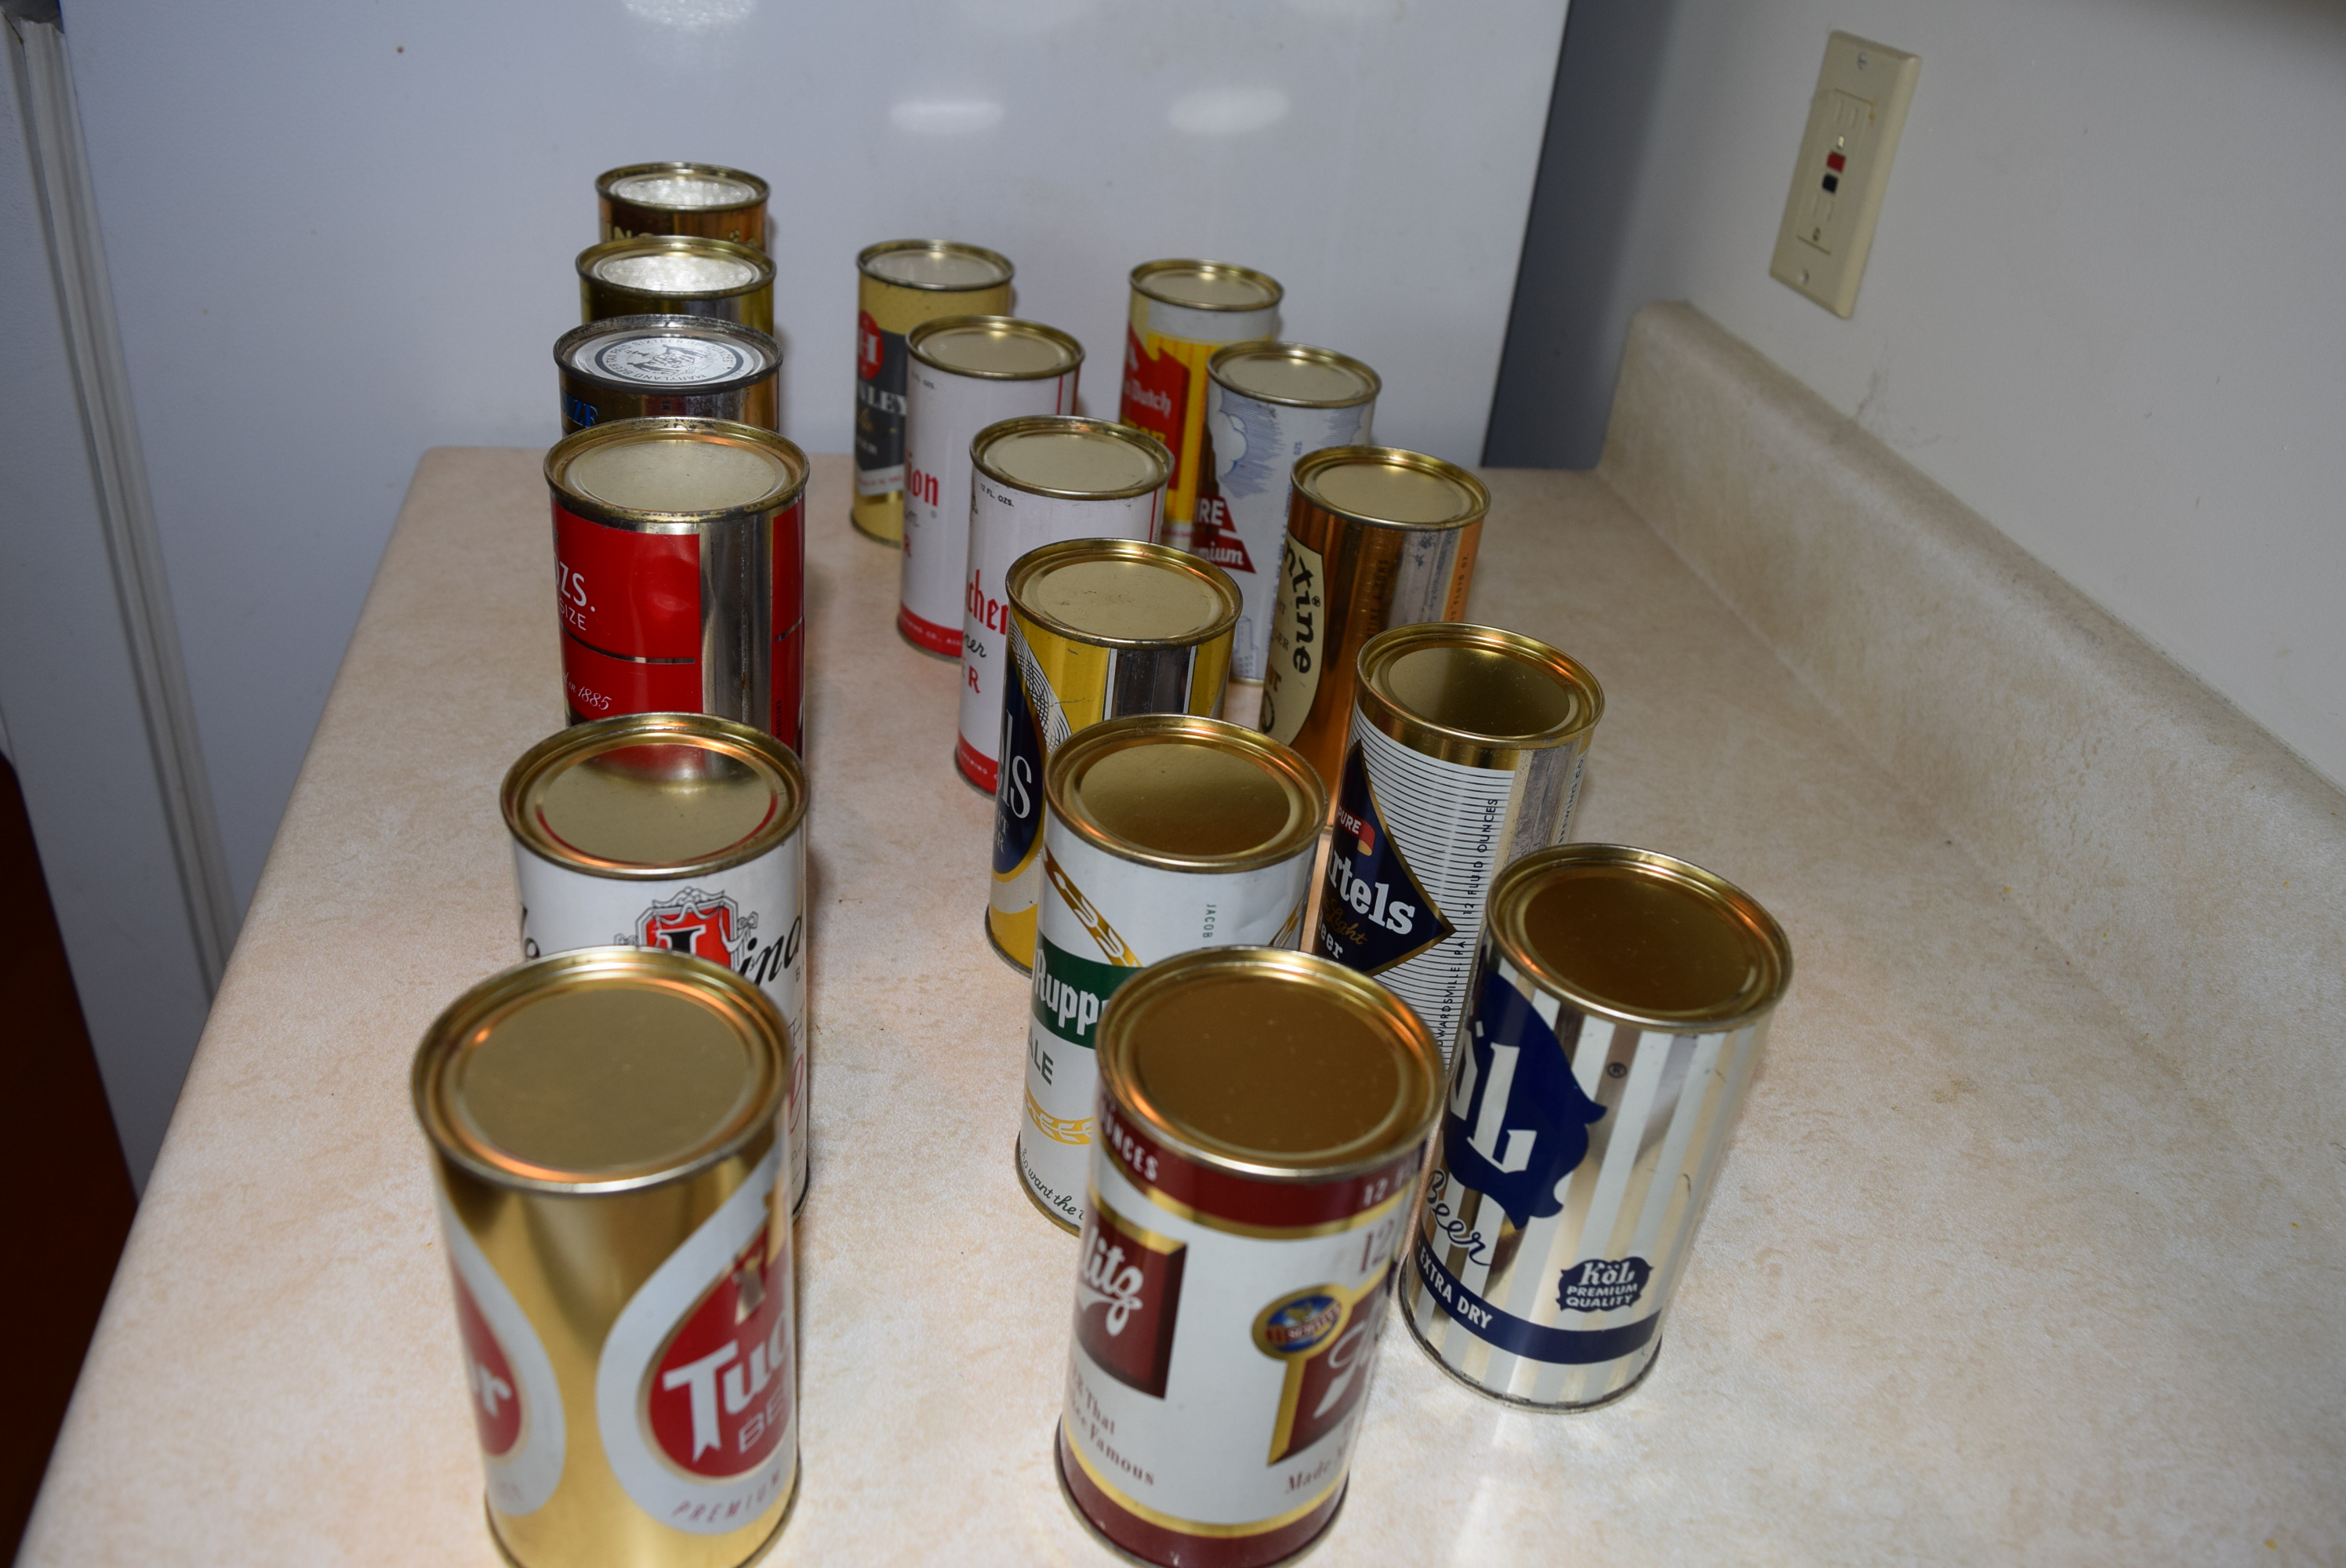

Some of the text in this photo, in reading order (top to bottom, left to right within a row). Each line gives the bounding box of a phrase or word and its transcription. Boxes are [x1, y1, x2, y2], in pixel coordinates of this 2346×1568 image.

[997, 495, 1015, 507] OZS.
[577, 687, 612, 710] 1885
[1337, 805, 1362, 835] PURE
[1477, 798, 1498, 854] OUNCES
[1327, 848, 1416, 935] rtels
[1467, 861, 1484, 896] FLUID
[1203, 903, 1217, 938] JACOB
[1463, 902, 1475, 915] 12
[1033, 947, 1106, 1036] Rupp
[1436, 962, 1464, 1051] DWARDSVILLE,
[1027, 1025, 1054, 1087] ALE
[1028, 1167, 1054, 1200] want
[1053, 1194, 1077, 1216] the
[1420, 1245, 1493, 1330] EXTRA DRY
[1565, 1294, 1633, 1308] QUALITY
[1566, 1283, 1638, 1298] PREMIUM
[1090, 1422, 1155, 1486] Famous
